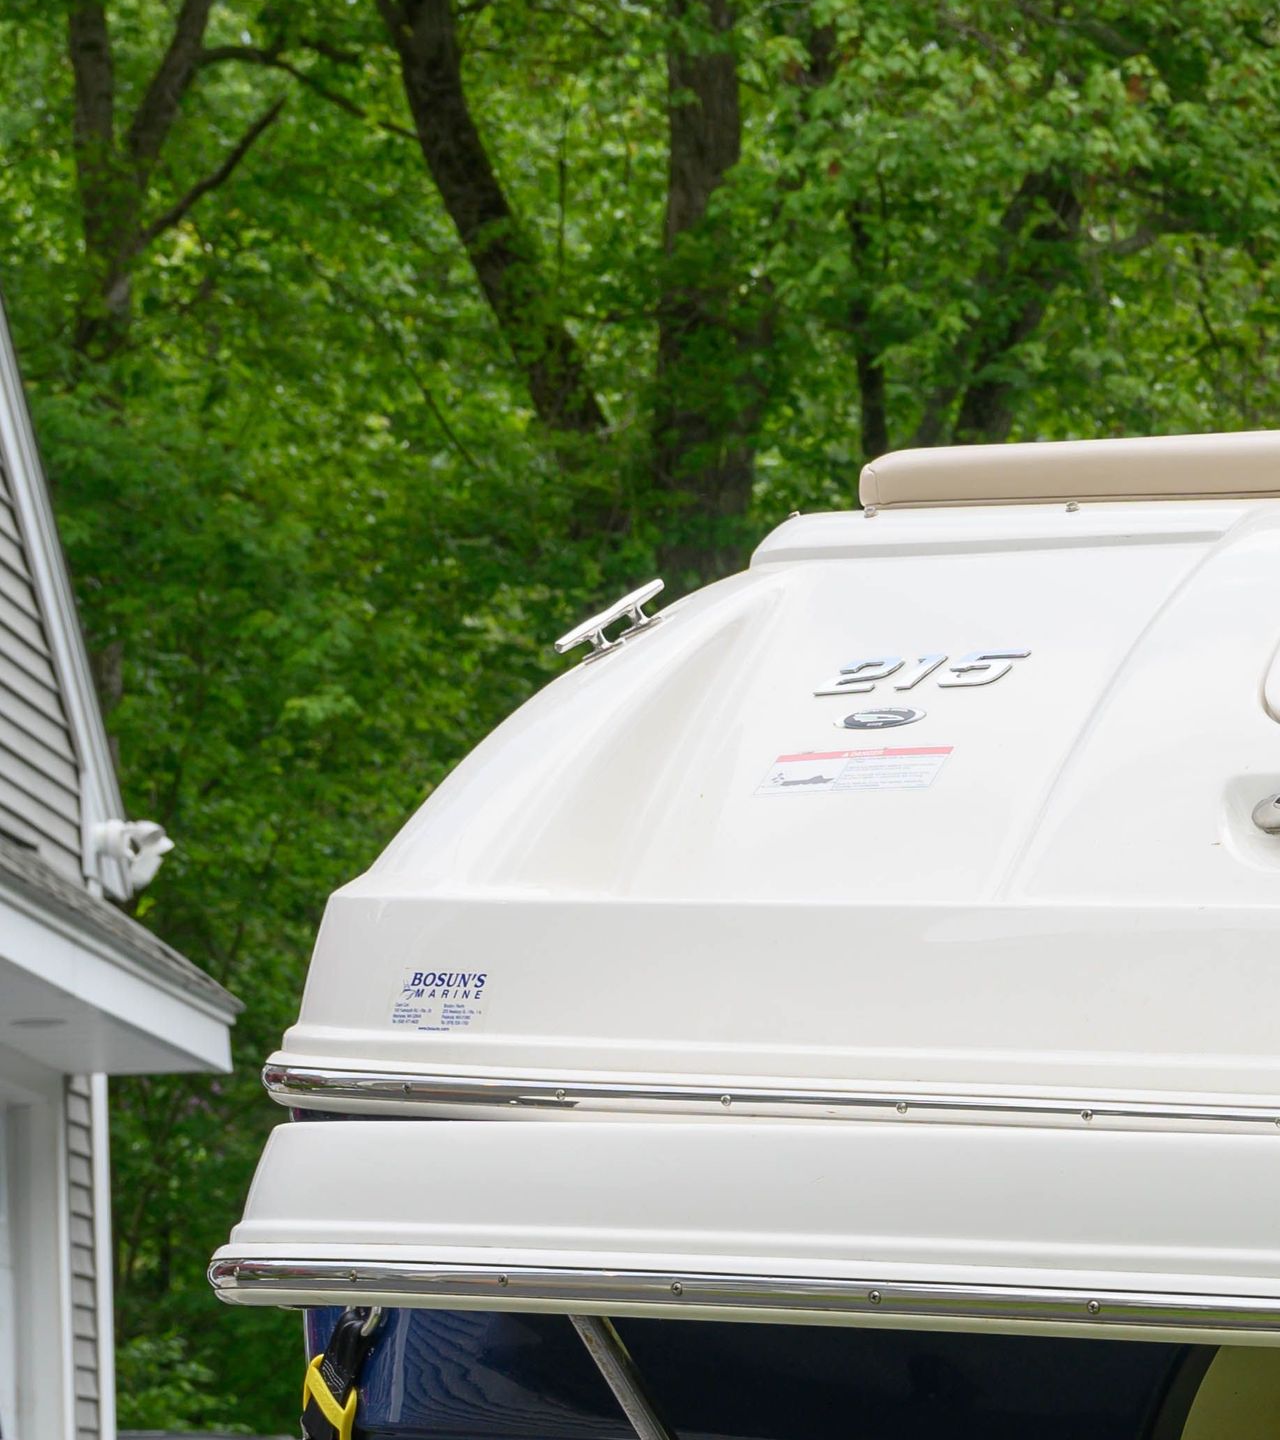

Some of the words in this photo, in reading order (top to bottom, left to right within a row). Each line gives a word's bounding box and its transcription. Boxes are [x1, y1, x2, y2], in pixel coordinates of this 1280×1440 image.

[813, 648, 1032, 696] 215
[411, 972, 487, 988] BOSUN'S
[415, 988, 482, 1000] MARINE
